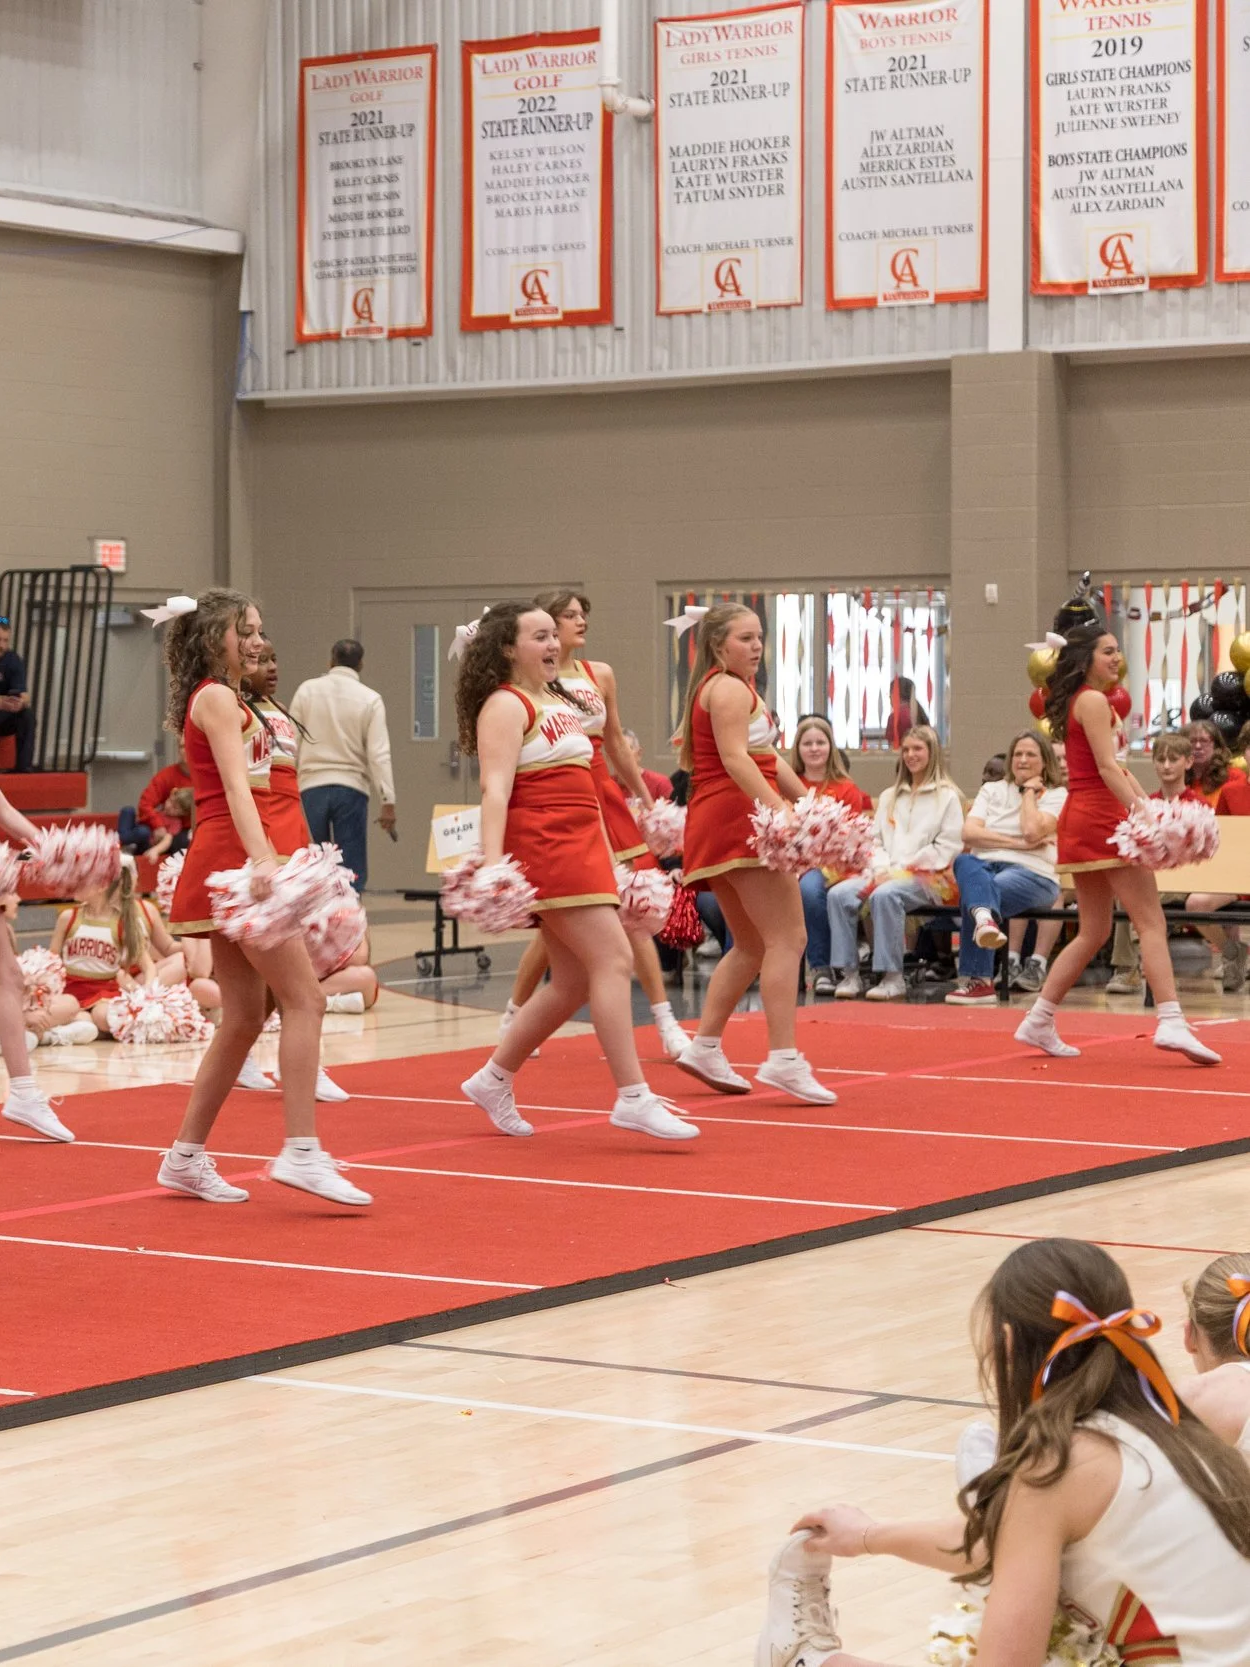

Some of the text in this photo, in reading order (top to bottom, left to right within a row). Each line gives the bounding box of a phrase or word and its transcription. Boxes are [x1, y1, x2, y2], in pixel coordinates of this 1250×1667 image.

[858, 7, 958, 30] WARRIOR
[1086, 11, 1152, 31] TENNIS
[665, 20, 794, 48] LADY WARRIOR
[860, 31, 952, 50] BOYS TENNIS
[680, 44, 778, 65] GIRLS TENNIS
[1091, 35, 1143, 58] 2019
[482, 50, 597, 74] LADY WARRIOR
[888, 54, 927, 73] 2021
[311, 66, 423, 90] LADY WARRIOR
[514, 74, 563, 91] GOLF
[710, 68, 748, 87] 2021
[845, 67, 972, 94] STATE RUNNER-UP
[1046, 59, 1192, 87] GIRLS STATE CHAMPIONS
[350, 90, 383, 103] GOLF
[669, 81, 791, 108] STATE RUNNER-UP
[1067, 81, 1171, 101] LAURYN FRANKS
[517, 95, 557, 115] 2022
[1069, 97, 1168, 117] KATE WURSTER
[350, 110, 383, 127] 2021
[481, 112, 594, 139] STATE RUNNER-UP
[1055, 111, 1181, 137] JULIENNE SWEENEY
[318, 123, 416, 146] STATE RUNNER-UP
[870, 124, 944, 145] JW ALTMAN
[489, 143, 586, 161] KELSEY WILSON
[669, 135, 791, 158] MADDIE HOOKER
[860, 138, 954, 158] ALEX ZARDIAN
[1048, 143, 1188, 167] BOYS STATE CHAMPIONS
[492, 158, 582, 175] HALEY CARNES
[671, 151, 788, 174] LAURYN FRANKS
[859, 154, 956, 173] MERRICK ESTES
[484, 173, 590, 190] MADDIE HOOKER
[675, 167, 784, 189] KATE WURSTER
[841, 169, 974, 191] AUSTIN SANTELLANA
[1078, 165, 1155, 184] JW ALTMAN
[486, 187, 588, 204] BROOKLYN LANE
[674, 183, 785, 204] TATUM SNYDER
[1051, 178, 1184, 200] AUSTIN SANTELLANA
[534, 202, 580, 216] HARRIS
[1070, 196, 1166, 214] ALEX ZARDAIN
[881, 226, 928, 239] MICHAEL
[931, 223, 974, 236] TURNER
[706, 240, 751, 252] MICHAEL
[753, 236, 794, 248] TURNER
